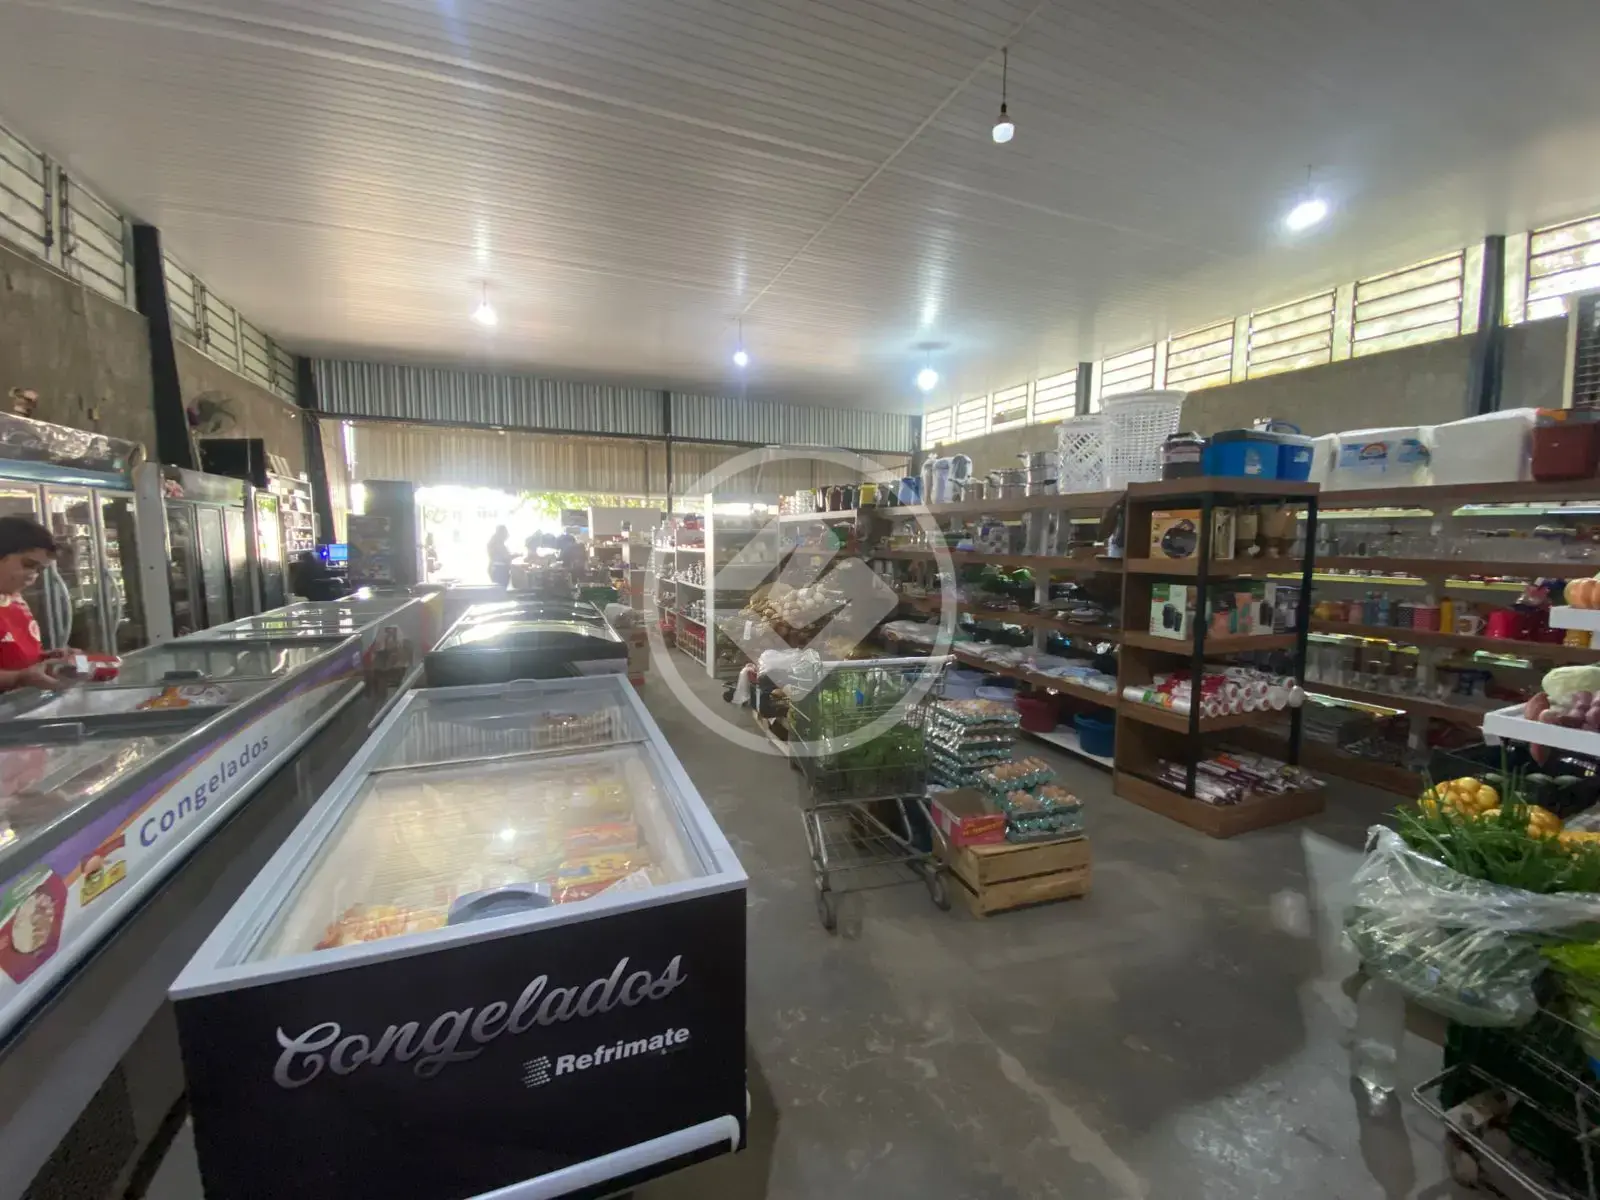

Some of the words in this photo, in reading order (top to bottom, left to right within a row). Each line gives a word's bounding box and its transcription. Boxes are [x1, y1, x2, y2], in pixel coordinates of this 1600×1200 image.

[140, 736, 269, 847] Congelados
[273, 954, 688, 1089] Congelados
[555, 1027, 690, 1075] Refrimate
